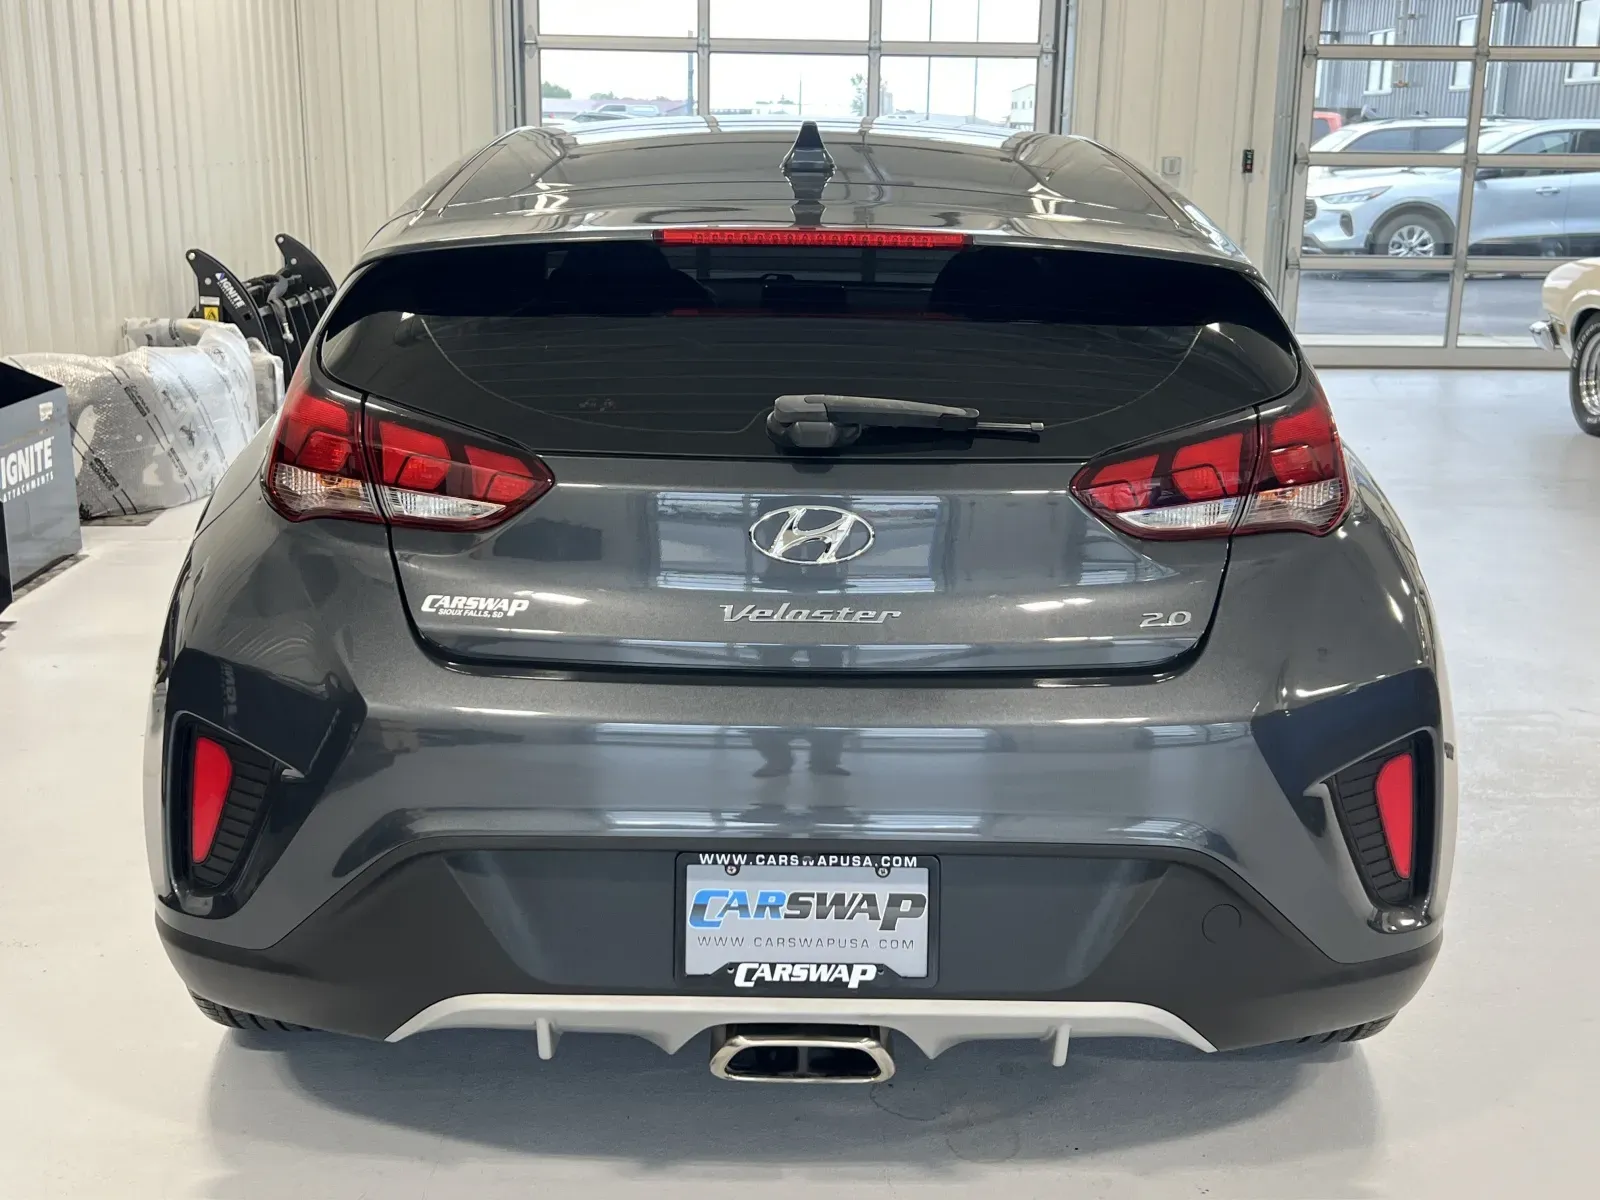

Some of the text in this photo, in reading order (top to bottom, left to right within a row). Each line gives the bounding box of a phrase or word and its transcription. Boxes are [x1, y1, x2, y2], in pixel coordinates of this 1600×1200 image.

[220, 277, 246, 308] IGNITE
[0, 436, 53, 490] IGNITE
[3, 470, 54, 503] ATTACHMENTS
[421, 594, 530, 617] CARSWAP
[438, 608, 463, 616] SIOUX
[463, 609, 491, 618] FALLS,
[719, 602, 902, 624] Veloster
[688, 888, 927, 931] CARSWAP
[697, 936, 915, 950] WWW.CARSWAPUSA.COM
[734, 962, 877, 989] CARSWAP
